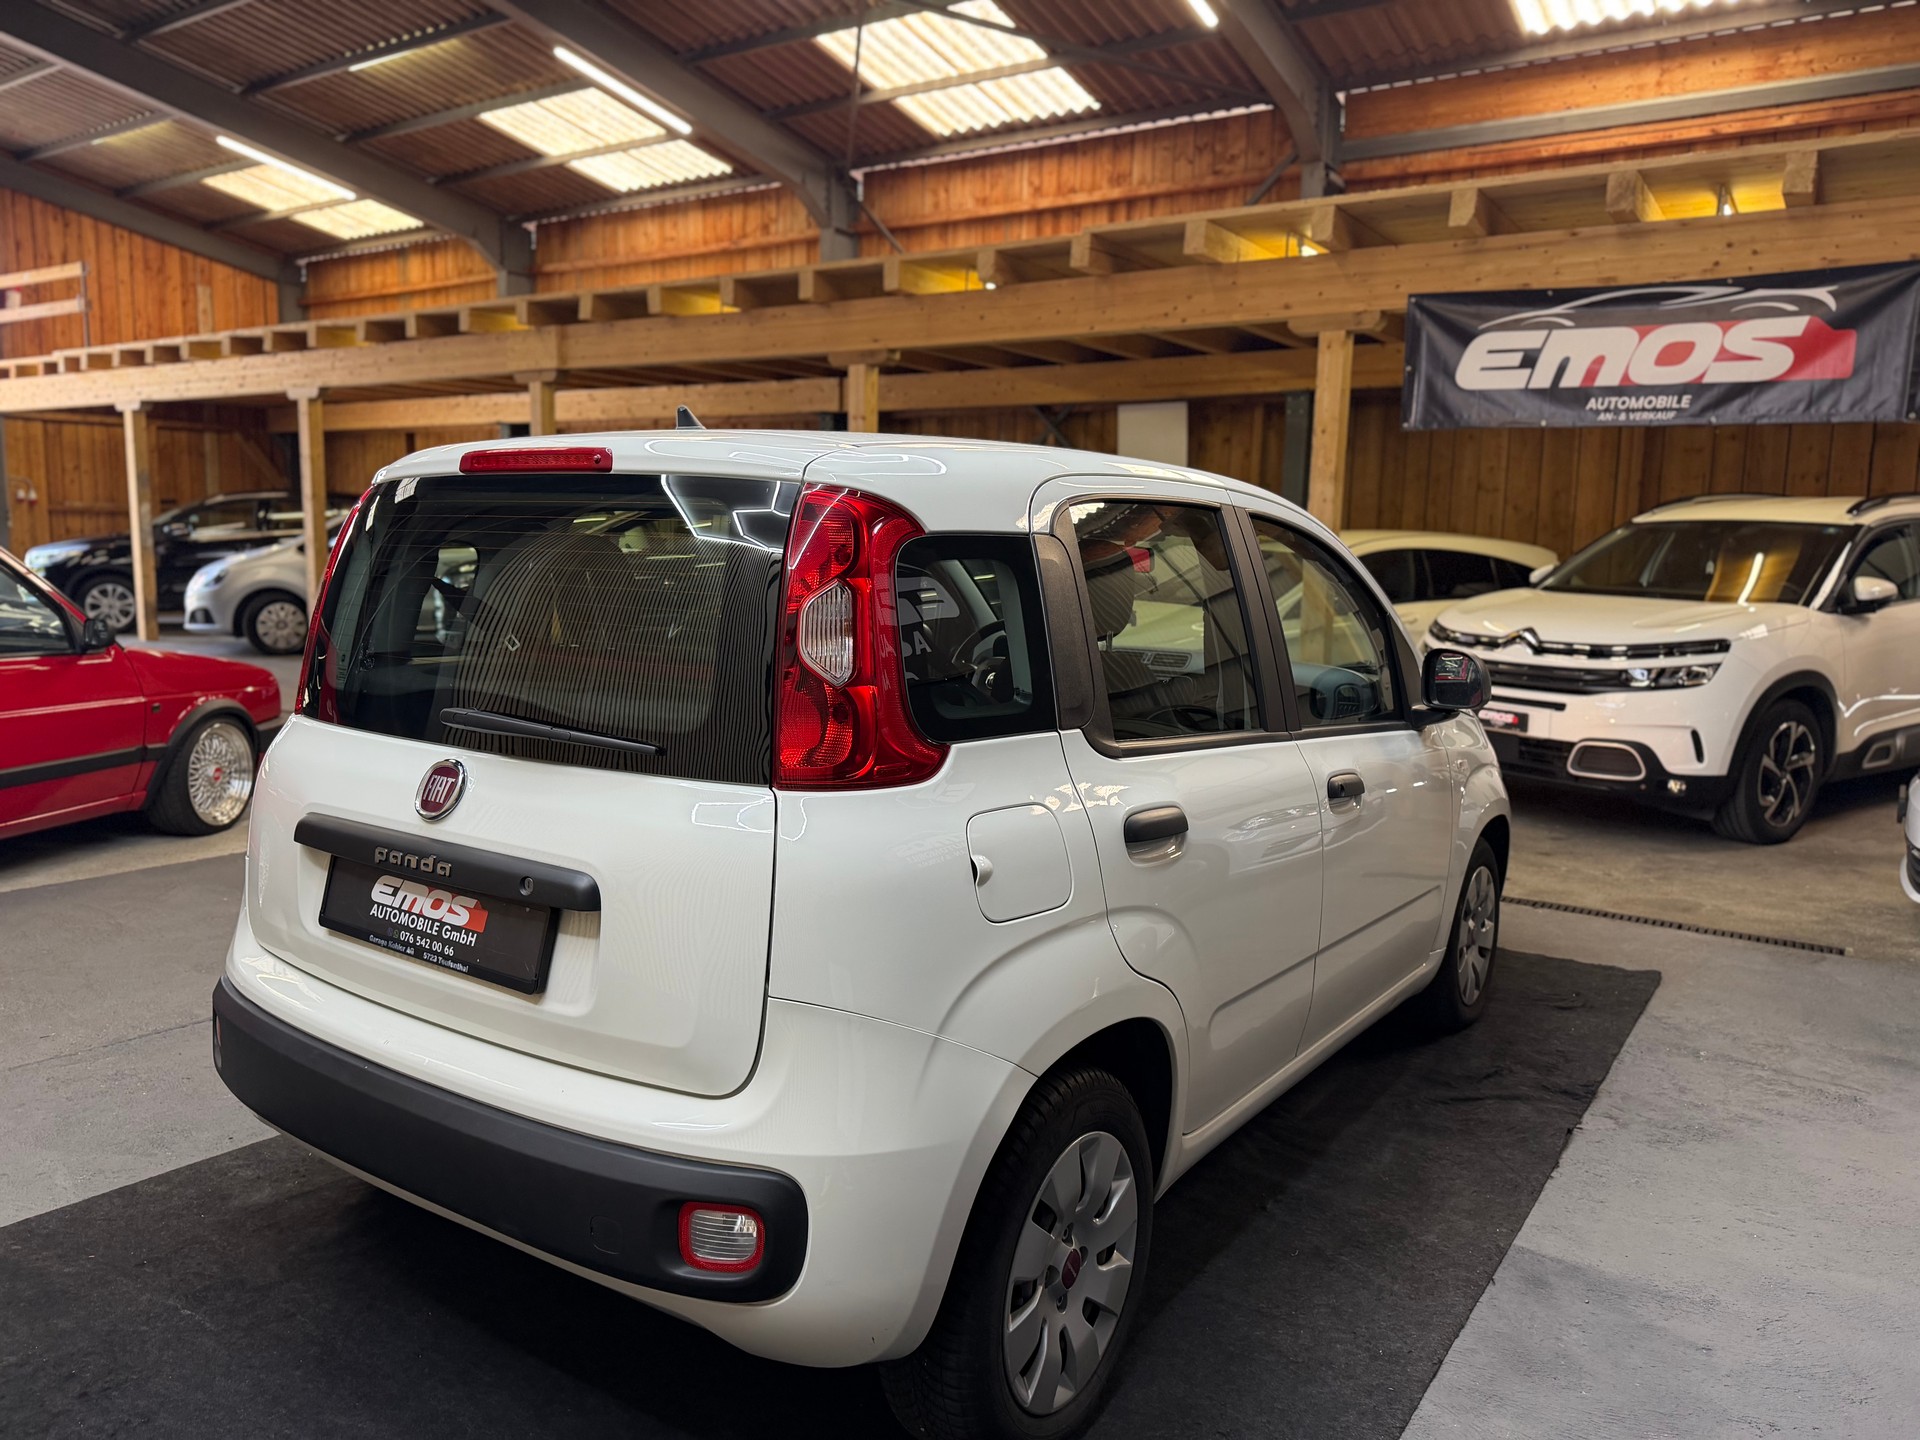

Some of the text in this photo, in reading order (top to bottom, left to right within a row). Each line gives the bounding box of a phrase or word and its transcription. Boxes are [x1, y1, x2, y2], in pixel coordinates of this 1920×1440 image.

[1455, 315, 1812, 391] EMOS
[1585, 394, 1693, 411] AUTOMOBILE
[1629, 410, 1678, 421] VERKAUF
[423, 775, 456, 804] FIAT
[374, 846, 452, 878] panda
[371, 875, 479, 927] EMOS
[370, 904, 477, 947] AUTOMOBILE GmbH
[400, 931, 454, 956] 076 542 00 66
